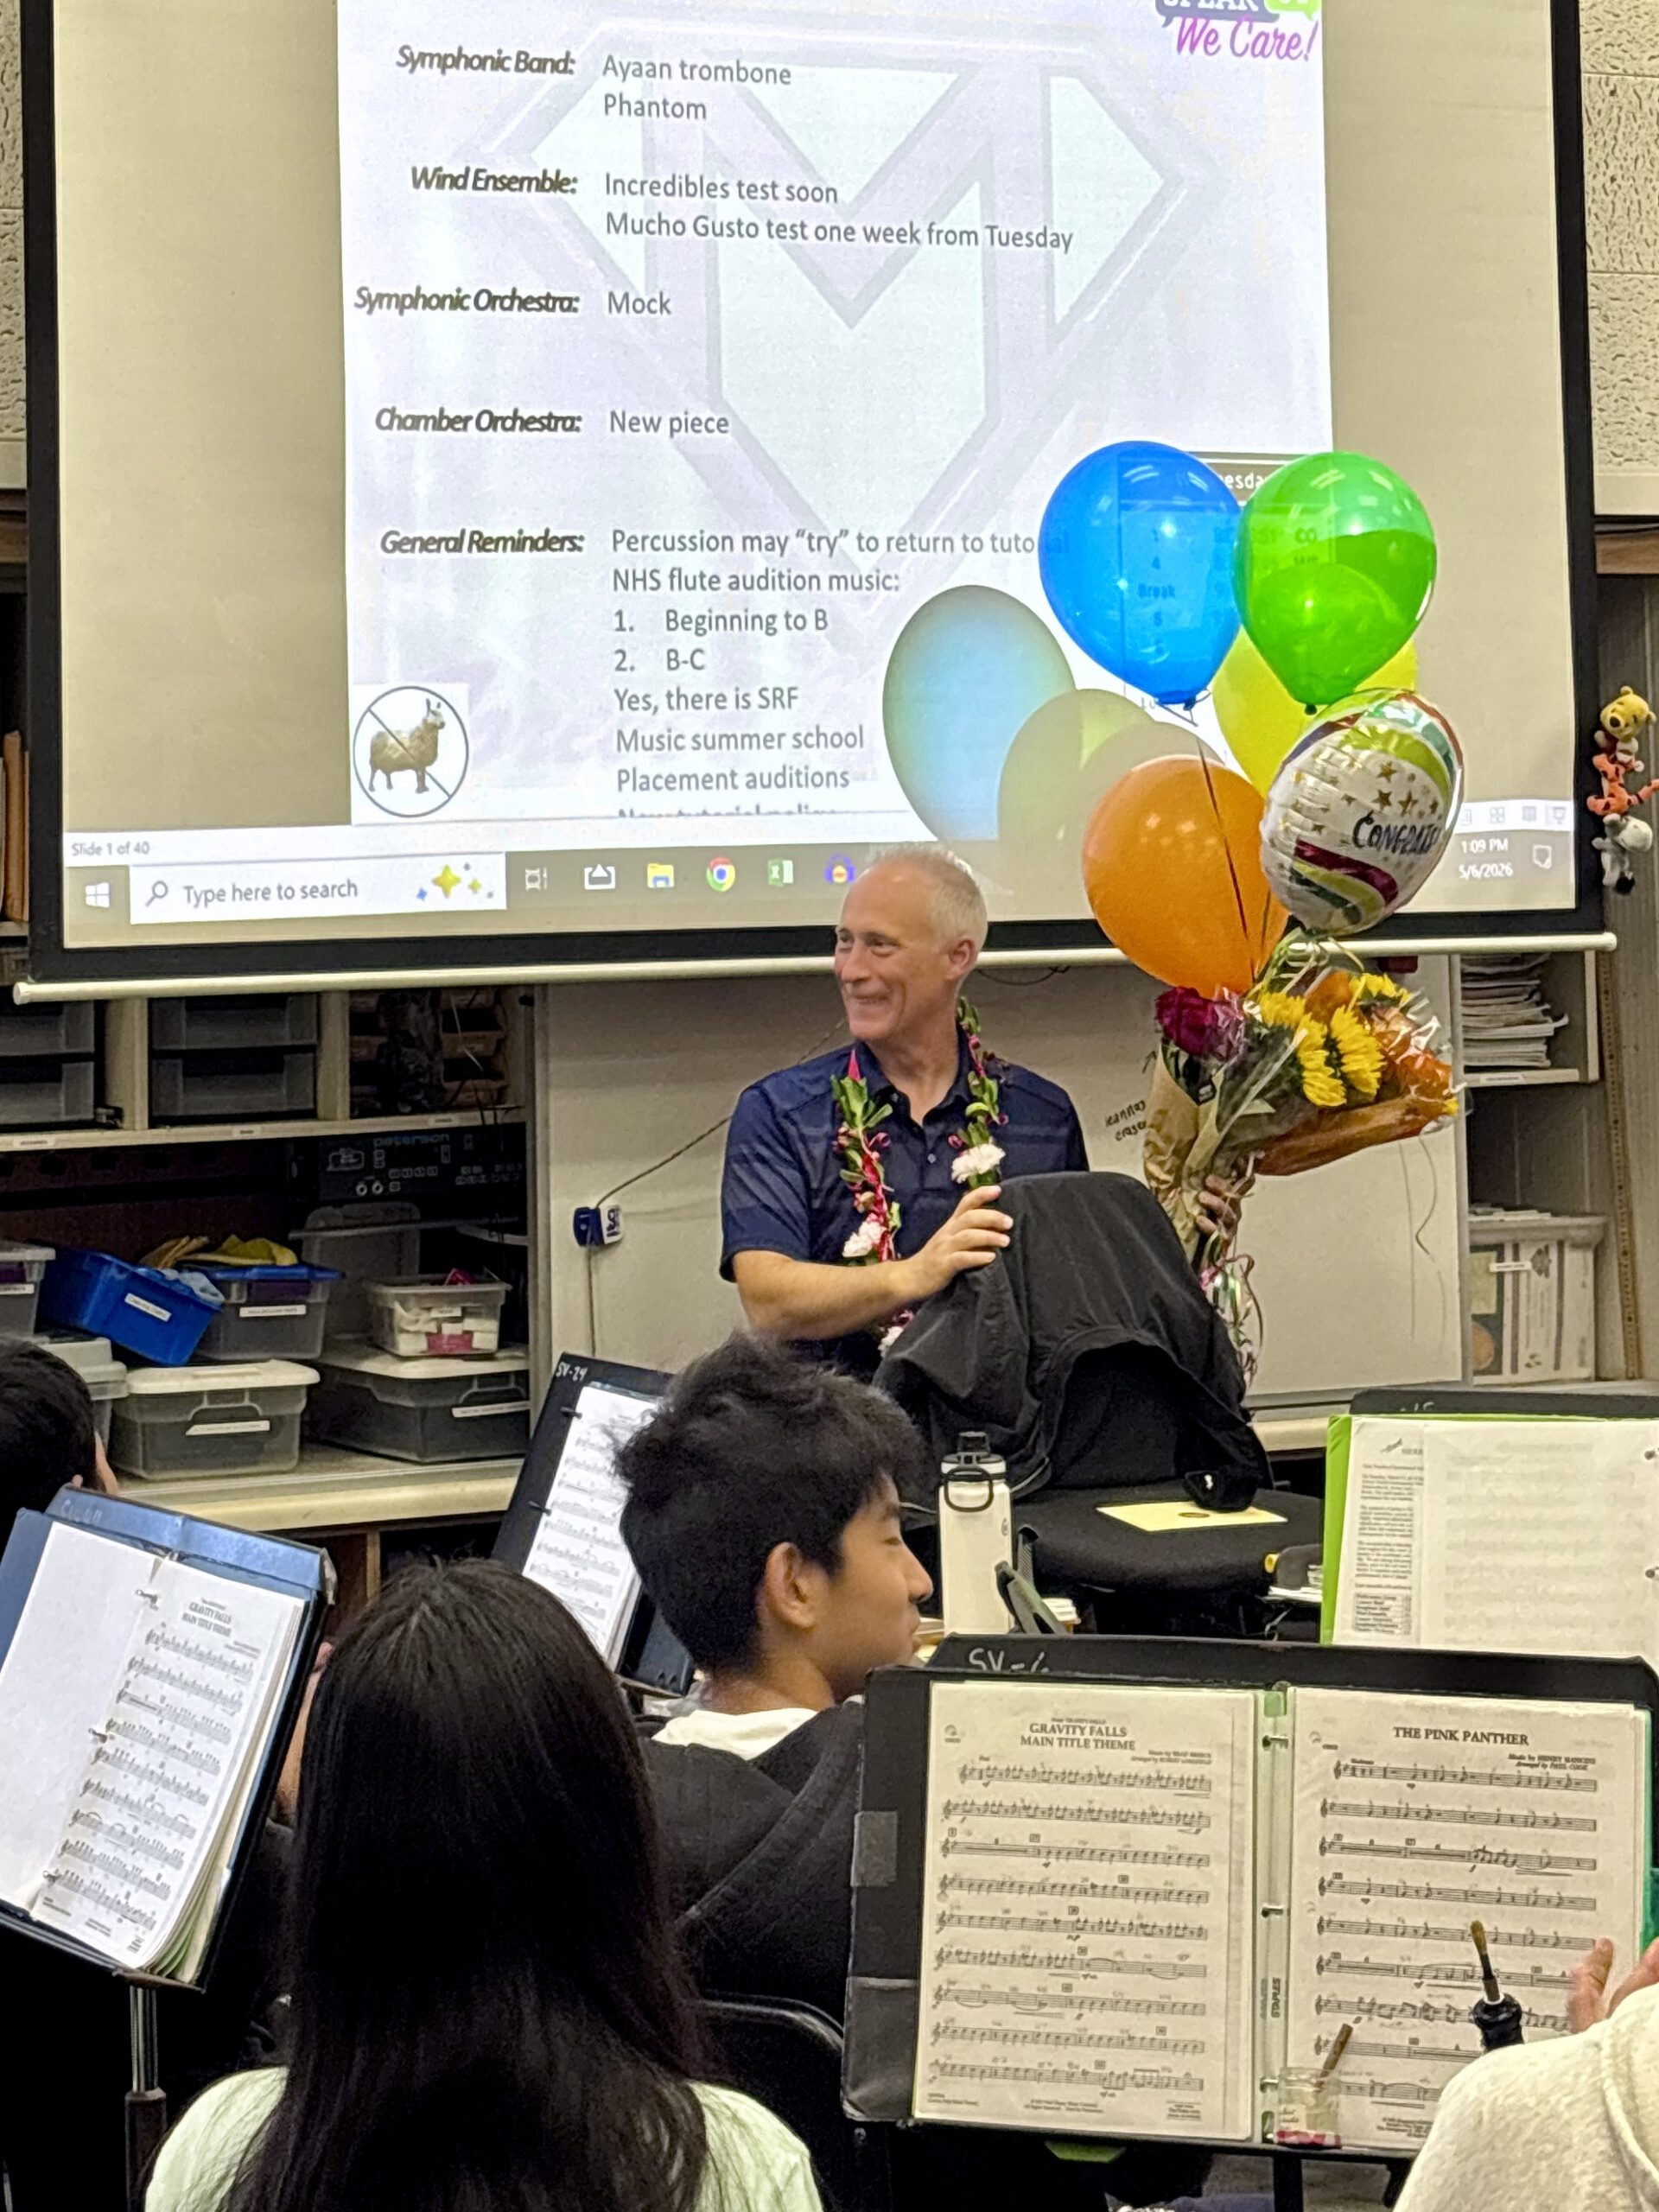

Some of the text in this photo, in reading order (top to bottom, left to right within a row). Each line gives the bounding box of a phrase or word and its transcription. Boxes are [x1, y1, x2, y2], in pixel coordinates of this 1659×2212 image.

[1176, 14, 1319, 62] We Care!
[397, 45, 575, 75] Symphonic Band:
[603, 54, 791, 85] Ayaan trombone
[605, 92, 706, 119] Phantom
[412, 166, 578, 194] Wind Ensemble:
[606, 173, 837, 203] Incredibles test soon
[607, 212, 1073, 254] Mucho Gusto test one week from Tuesday
[354, 286, 580, 315] Symphonic Orchestra:
[608, 290, 671, 315] Mock
[376, 407, 582, 432] Chamber Orchestra:
[611, 410, 728, 438] New piece
[381, 528, 584, 553] General Reminders:
[613, 530, 734, 552] Percussion
[742, 536, 789, 557] may
[856, 532, 879, 552] to
[887, 533, 954, 553] return
[961, 533, 982, 553] to
[613, 567, 899, 591] NHS flute audition music:
[615, 608, 828, 637] 1. Beginning to B
[614, 648, 704, 671] 2. B-C
[614, 687, 798, 715] Yes, there is SRF
[617, 724, 863, 753] Music summer school
[618, 765, 849, 791] Placement auditions
[72, 842, 149, 856] Slide 1 of 40
[1489, 837, 1509, 852] PM
[183, 879, 358, 908] Type here to search
[1020, 1735, 1135, 1751] MAIN TITLE THEME
[1029, 1722, 1128, 1738] GRAVITY FALLS
[1393, 1726, 1529, 1746] THE PINK PANTHER
[1271, 1976, 1281, 2018] STAPLES
